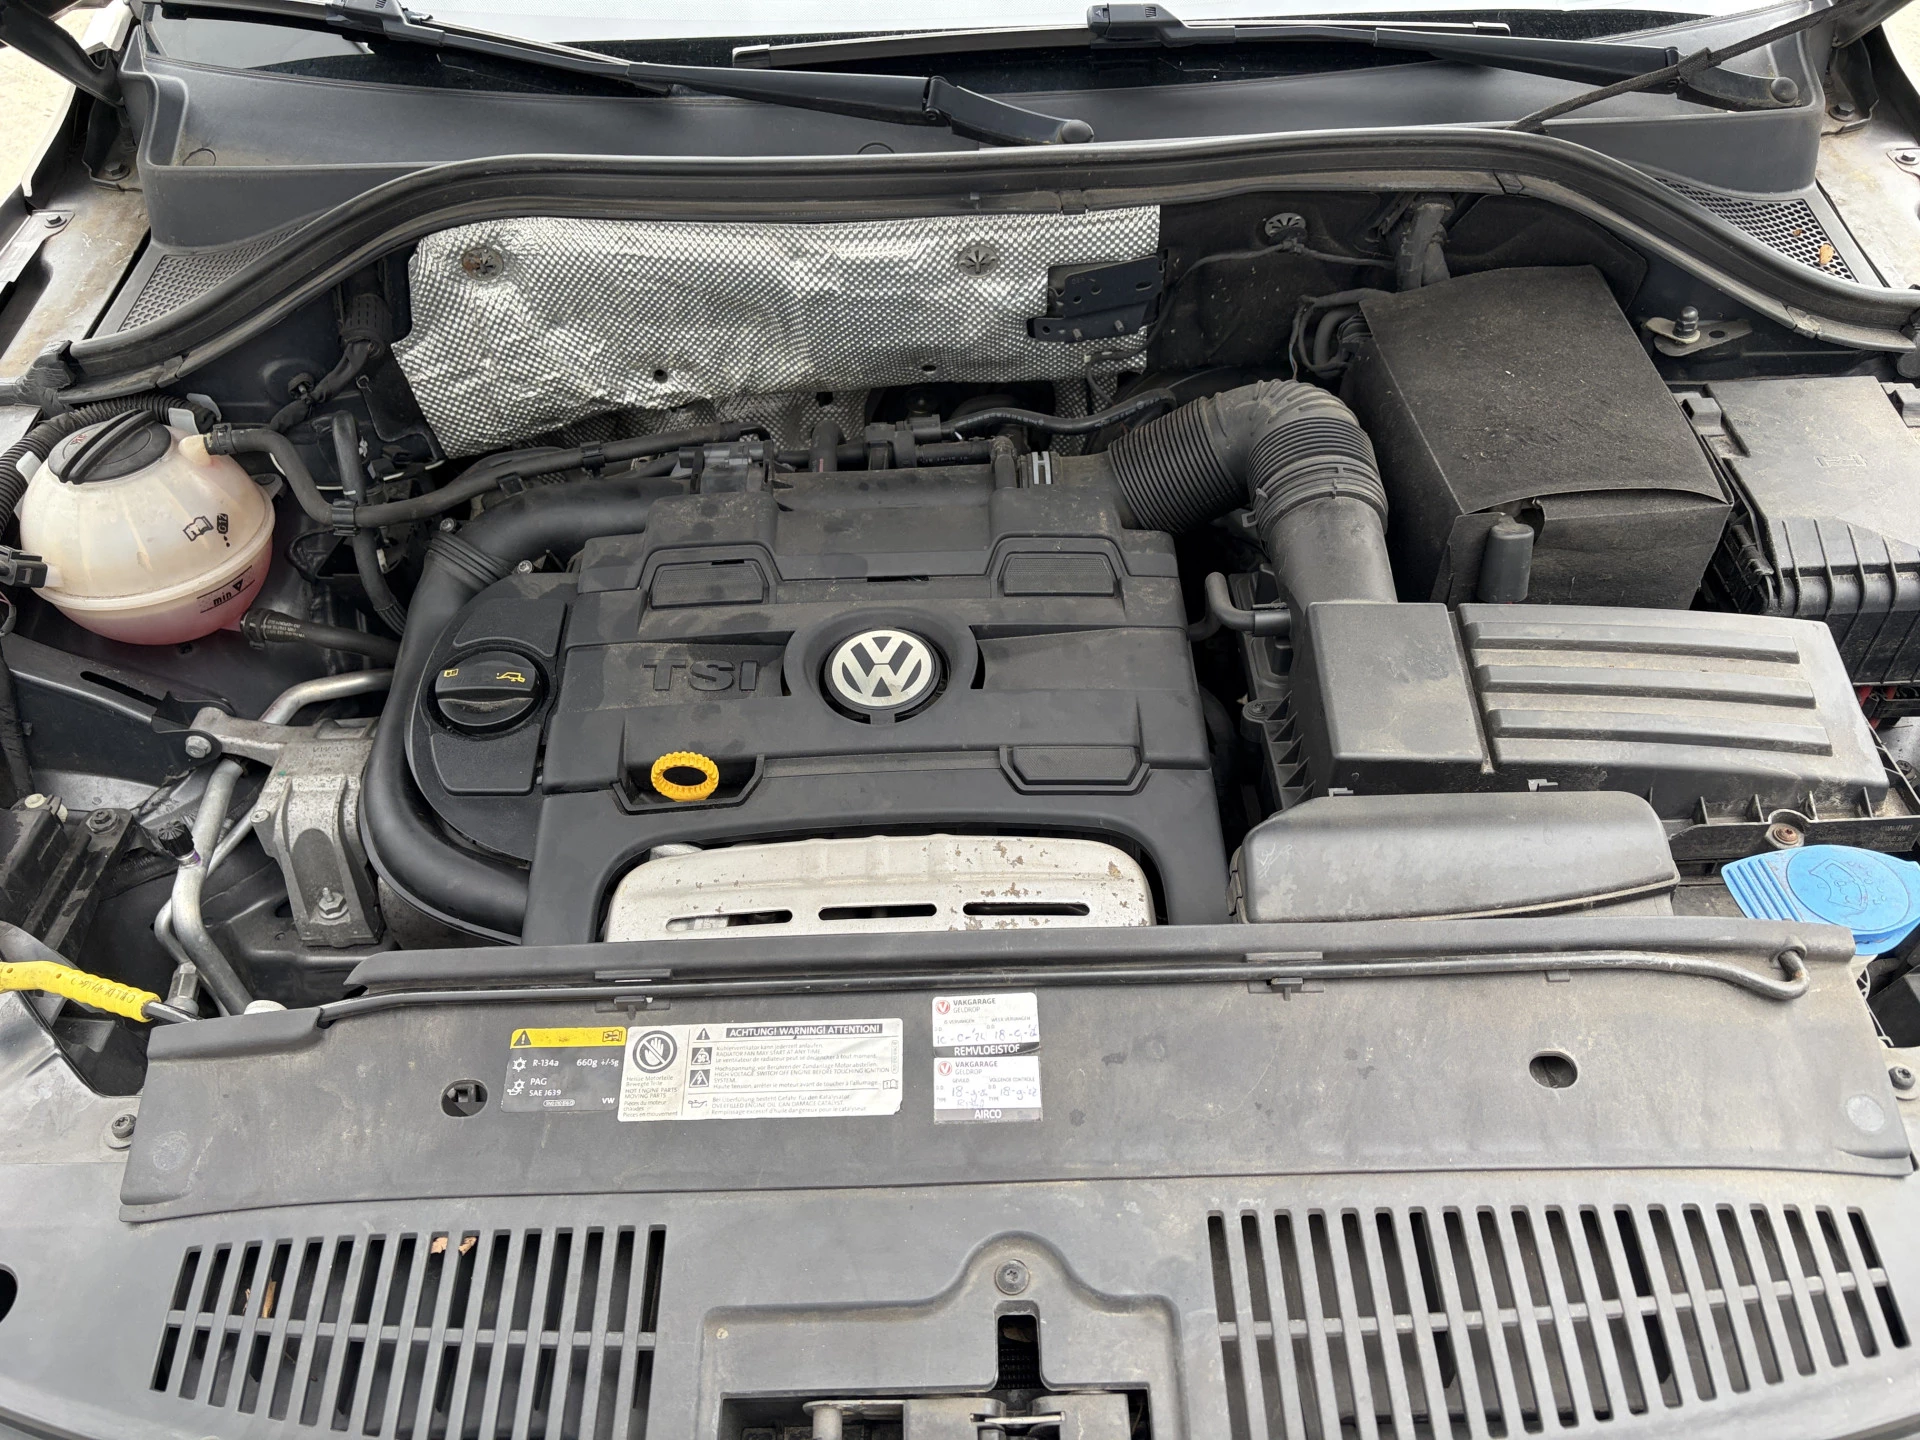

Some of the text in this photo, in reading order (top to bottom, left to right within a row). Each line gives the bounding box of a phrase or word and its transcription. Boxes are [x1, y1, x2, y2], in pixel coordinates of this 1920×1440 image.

[212, 591, 233, 607] min
[643, 659, 759, 692] TSI
[953, 998, 996, 1006] VAKGARAGE
[729, 1024, 880, 1037] ACHTUNG! WARNING! ATTENTION!
[954, 1044, 1020, 1056] REMVLOEISTOF
[532, 1058, 619, 1068] R-134a 660g +/-5g
[530, 1078, 548, 1086] PAG
[974, 1110, 1002, 1119] AIRCO
